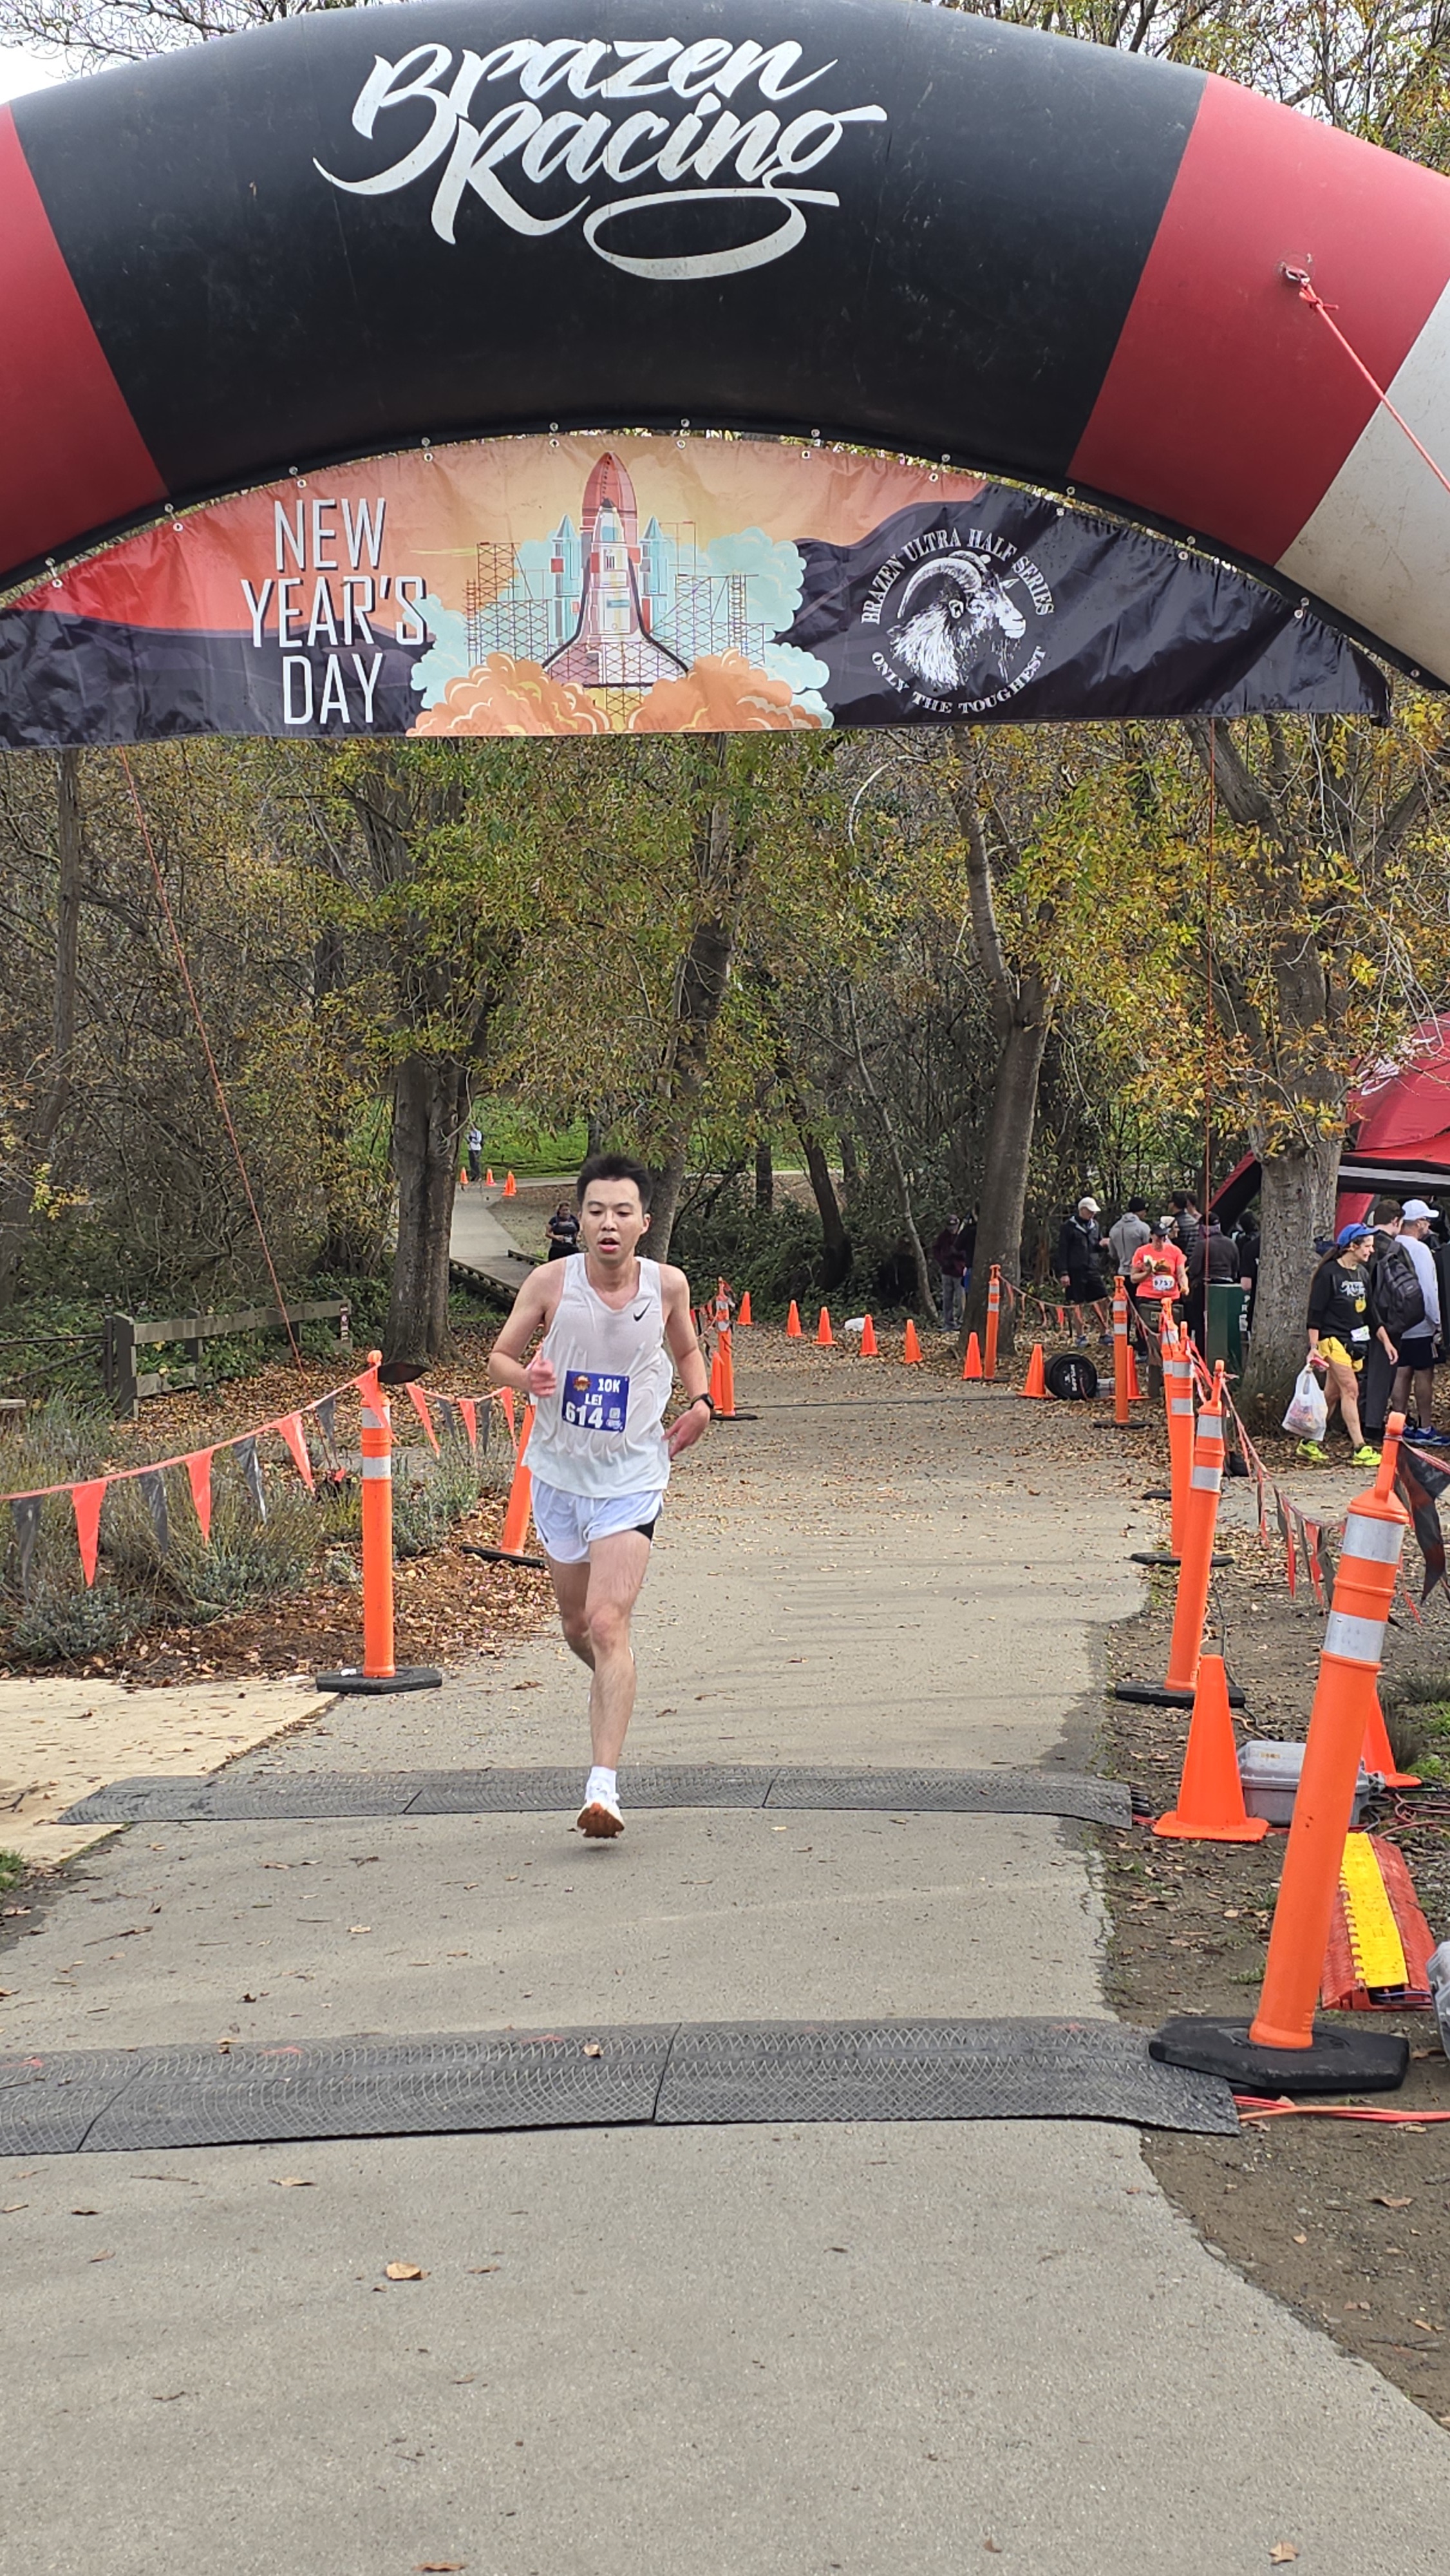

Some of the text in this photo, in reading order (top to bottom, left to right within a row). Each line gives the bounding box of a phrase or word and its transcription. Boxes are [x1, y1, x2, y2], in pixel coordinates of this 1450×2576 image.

[312, 36, 838, 195] Brazen
[430, 91, 888, 280] Racing
[274, 497, 385, 571] NEW
[861, 527, 1055, 625] BRAZEN ULTRA HALF SERIES
[241, 576, 428, 648] YEAR'S
[282, 653, 384, 724] DAY
[872, 645, 1046, 714] ONLY THE TOUGHEST
[565, 1401, 603, 1428] 614
[585, 1393, 603, 1406] LEI
[597, 1378, 621, 1393] 10K
